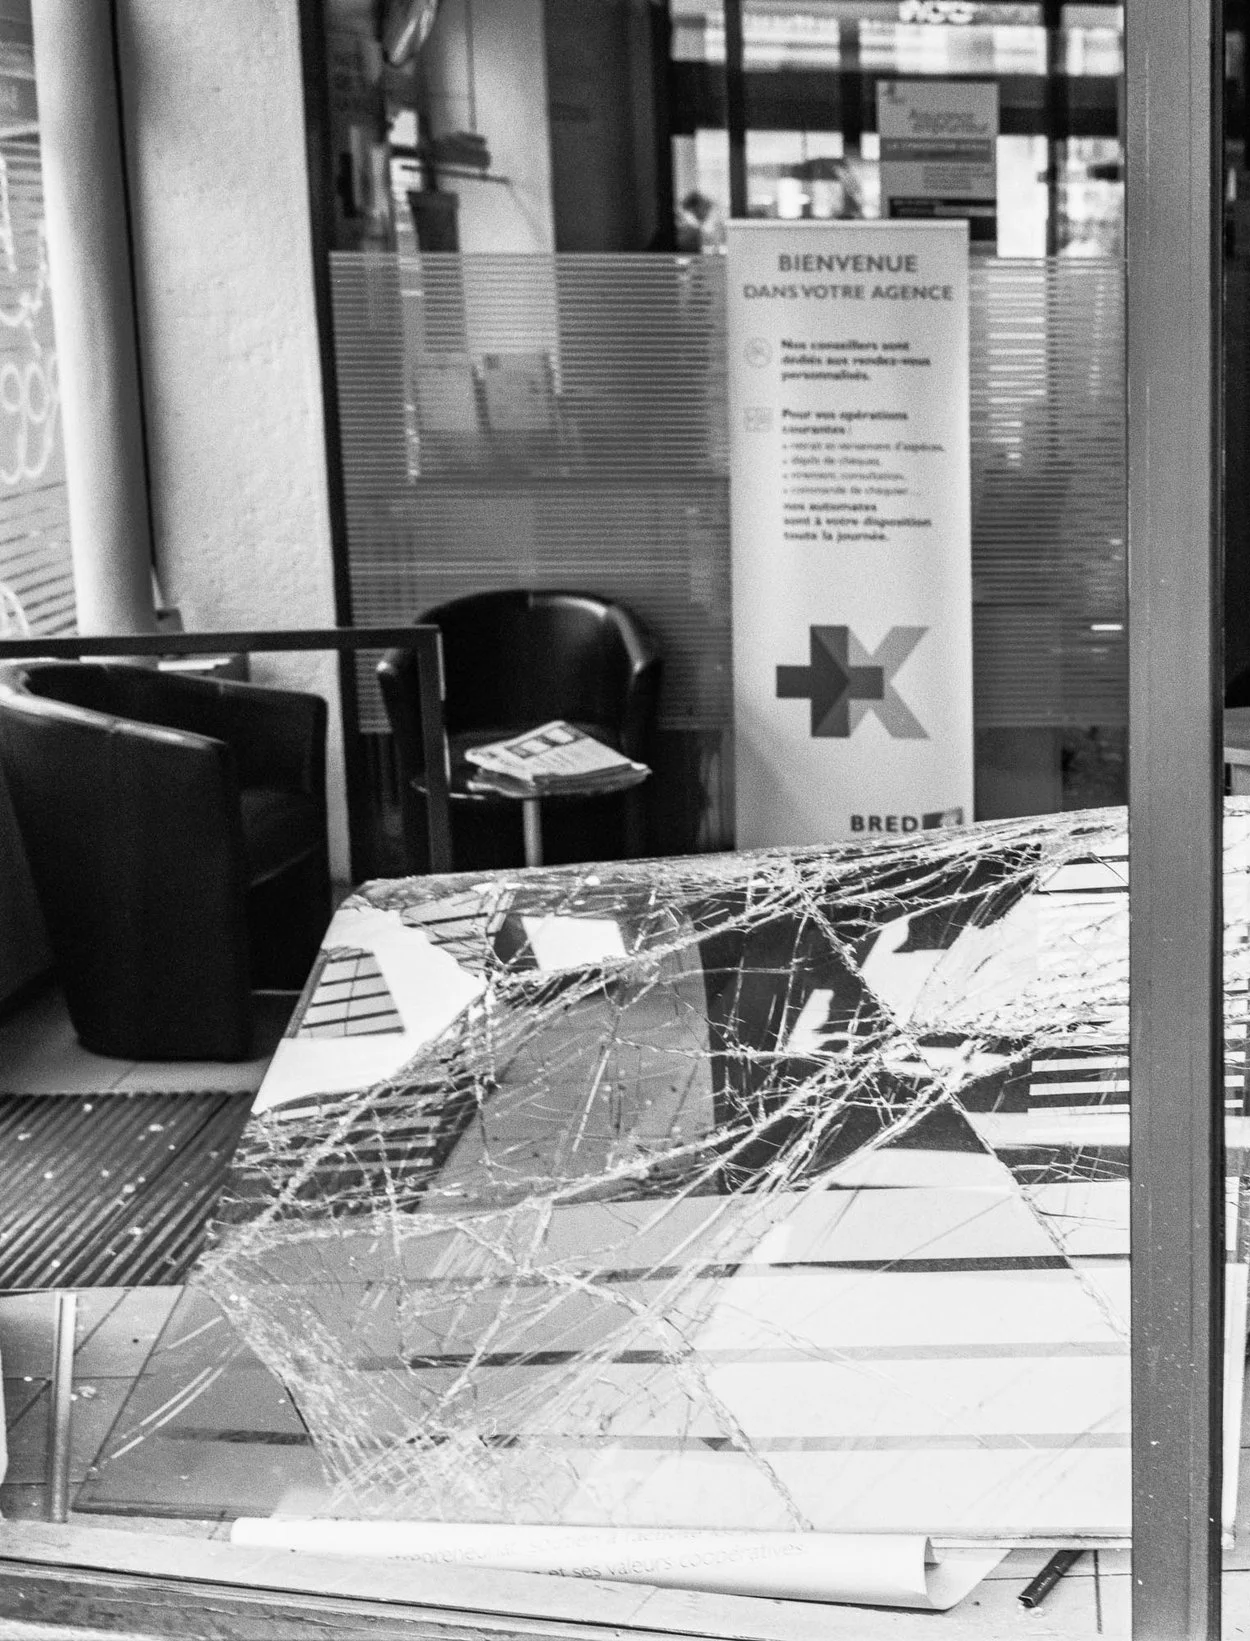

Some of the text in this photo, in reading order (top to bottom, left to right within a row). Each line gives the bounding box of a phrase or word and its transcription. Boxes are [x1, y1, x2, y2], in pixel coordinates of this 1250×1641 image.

[778, 253, 919, 273] BIENVENUE
[743, 283, 955, 301] DANS VOTRE AGENCE
[850, 814, 919, 833] BRED
